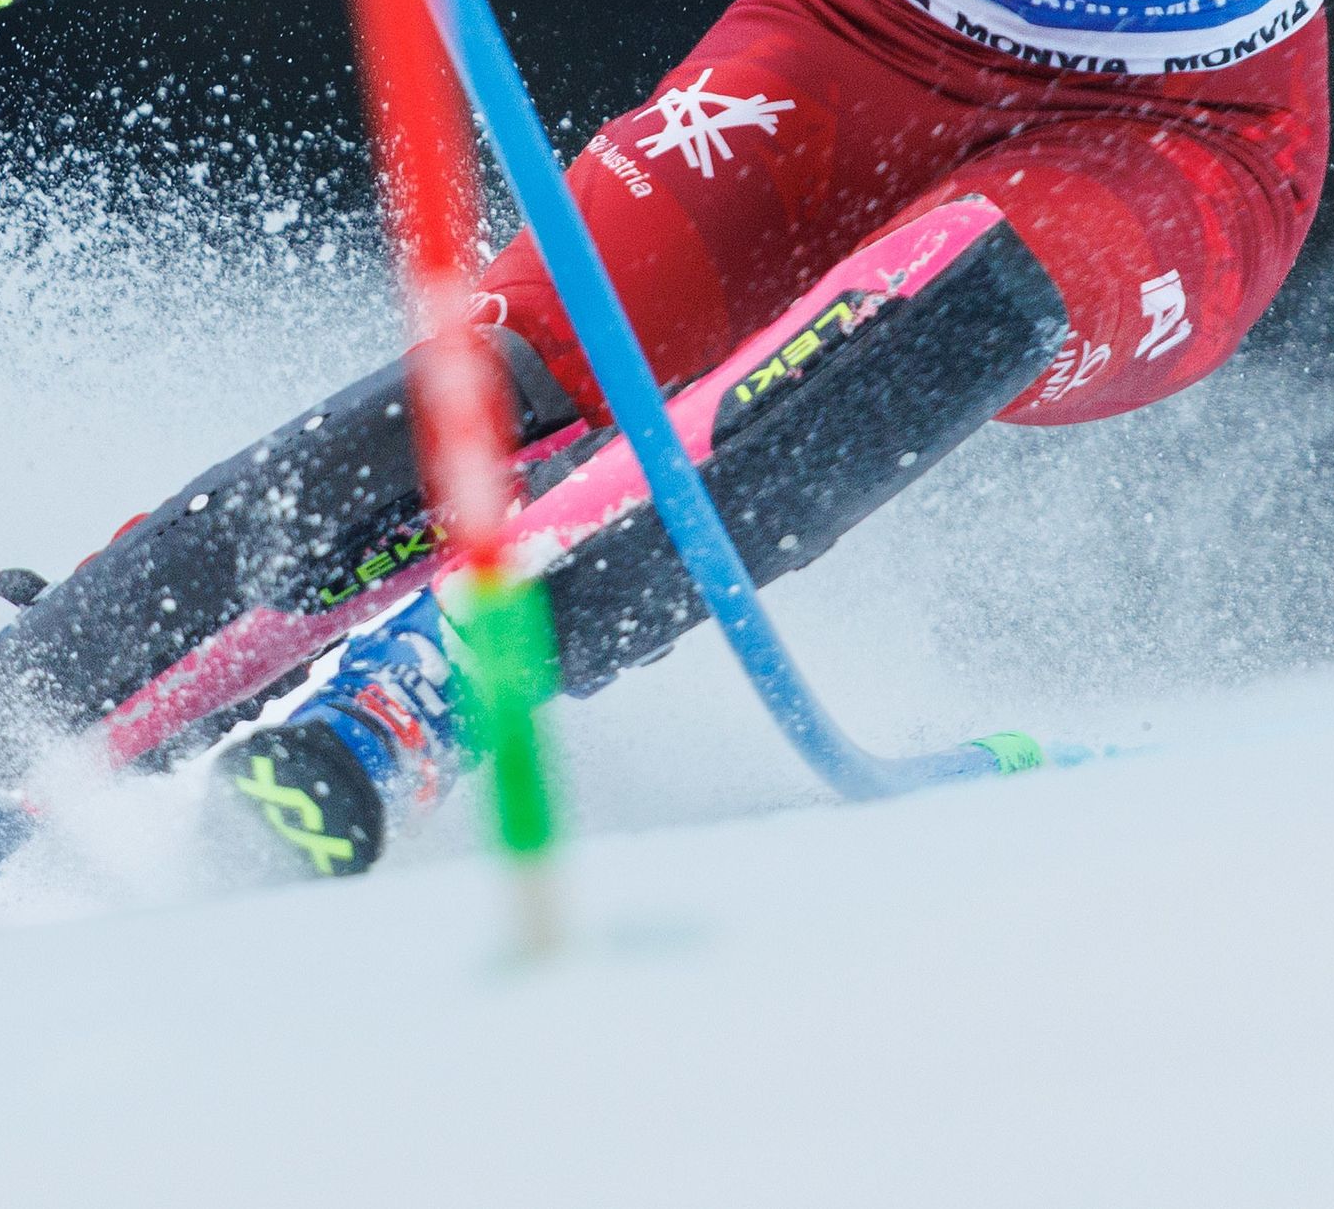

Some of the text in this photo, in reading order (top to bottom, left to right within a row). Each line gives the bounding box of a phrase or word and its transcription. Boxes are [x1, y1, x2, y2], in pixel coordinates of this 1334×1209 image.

[955, 10, 1130, 74] MONVIA
[596, 144, 654, 199] Austria
[735, 301, 854, 404] LEKI
